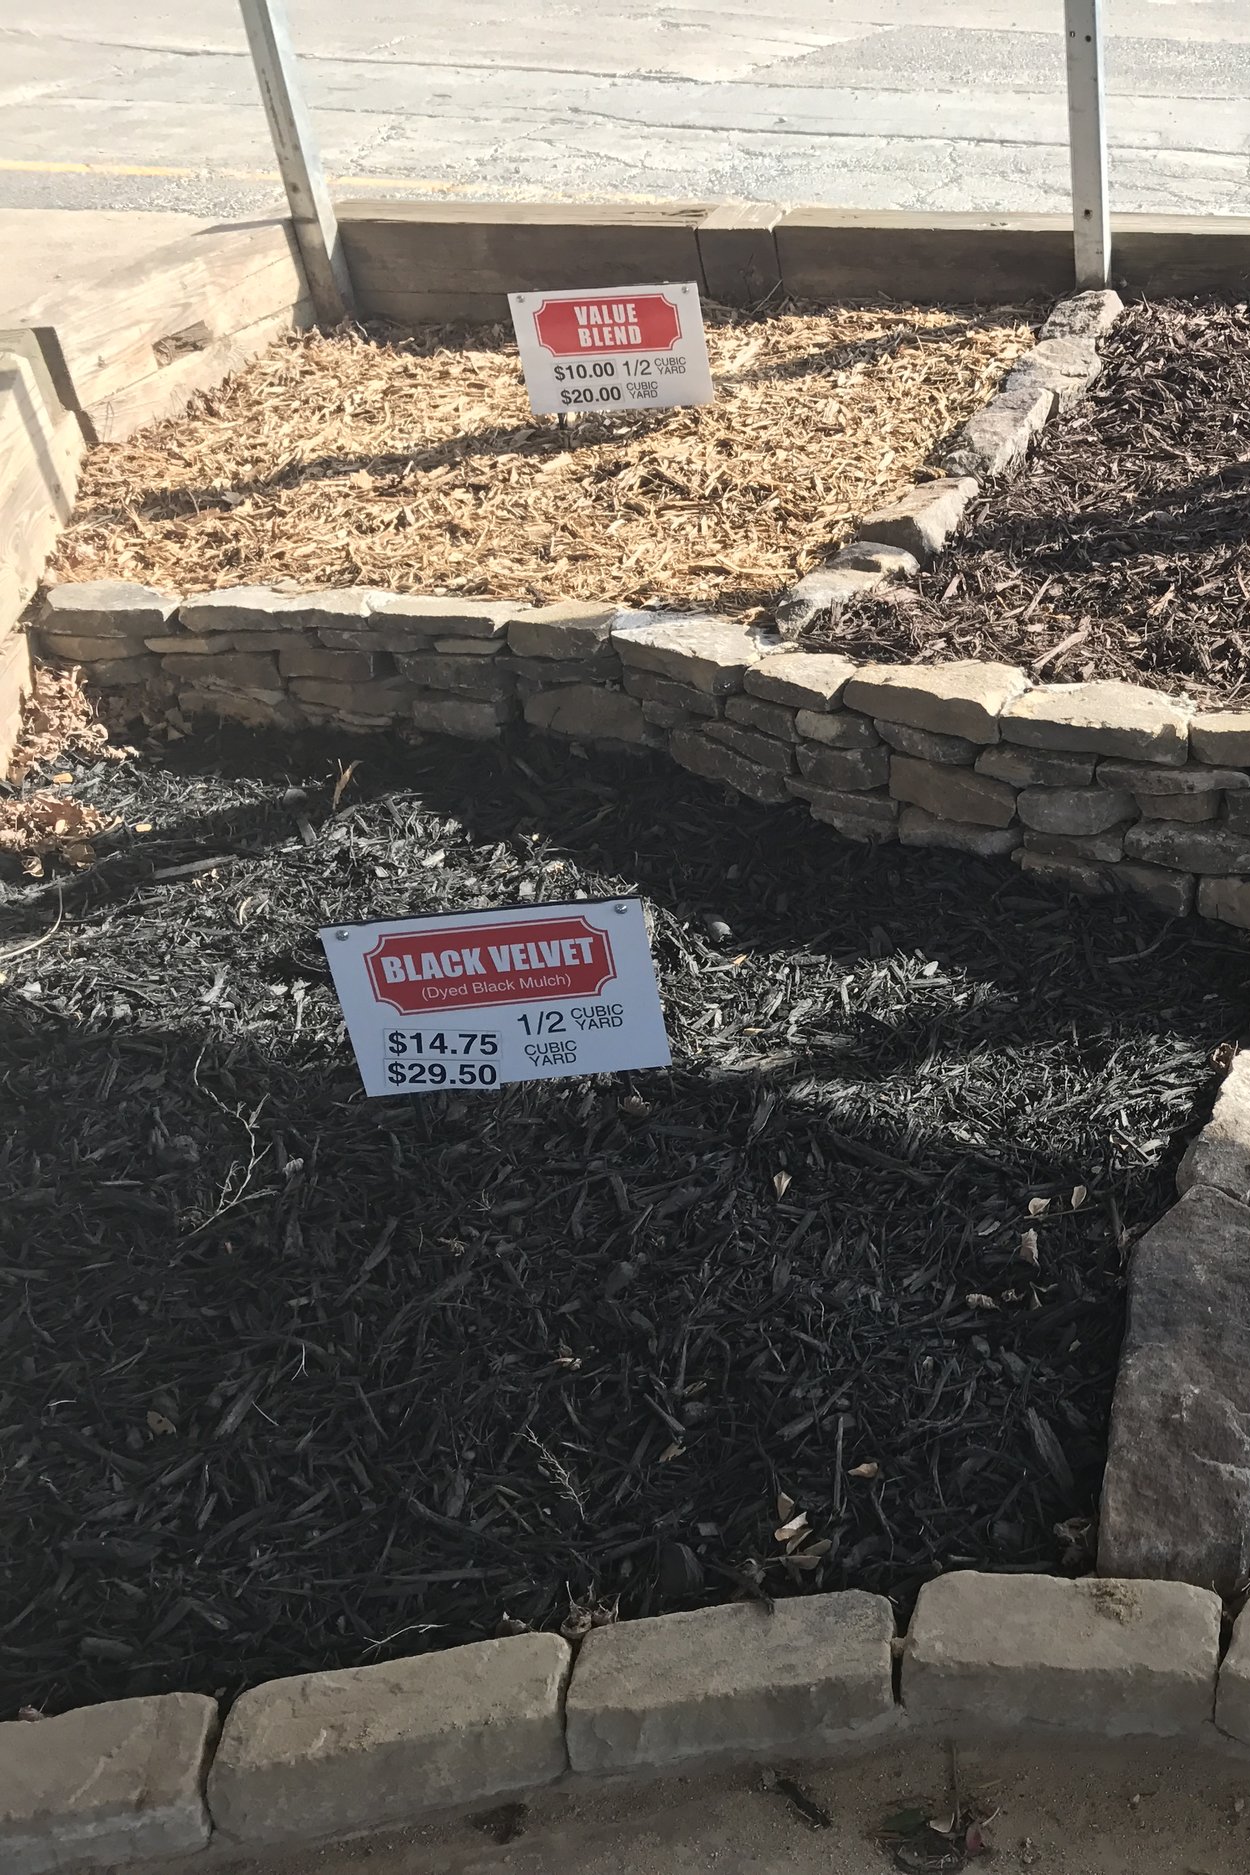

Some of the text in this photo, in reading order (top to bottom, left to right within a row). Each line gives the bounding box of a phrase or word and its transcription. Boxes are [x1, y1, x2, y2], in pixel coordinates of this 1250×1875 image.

[574, 304, 638, 325] VALUE
[578, 325, 642, 347] BLEND
[554, 360, 651, 381] $10.00 1/2
[654, 357, 686, 366] CUBIC
[658, 366, 686, 375] YARD
[627, 381, 658, 390] CUBIC
[629, 390, 658, 399] YARD
[560, 386, 621, 405] $20.00
[380, 937, 594, 984] BLACK VELVET
[422, 974, 571, 1002] (Dyed Black Mulch)
[570, 1004, 624, 1020] CUBIC
[517, 1011, 566, 1036] 1/2
[574, 1016, 623, 1030] YARD
[388, 1031, 498, 1056] $14.75
[524, 1040, 577, 1056] CUBIC
[529, 1052, 577, 1067] YARD
[388, 1061, 497, 1086] $29.50
